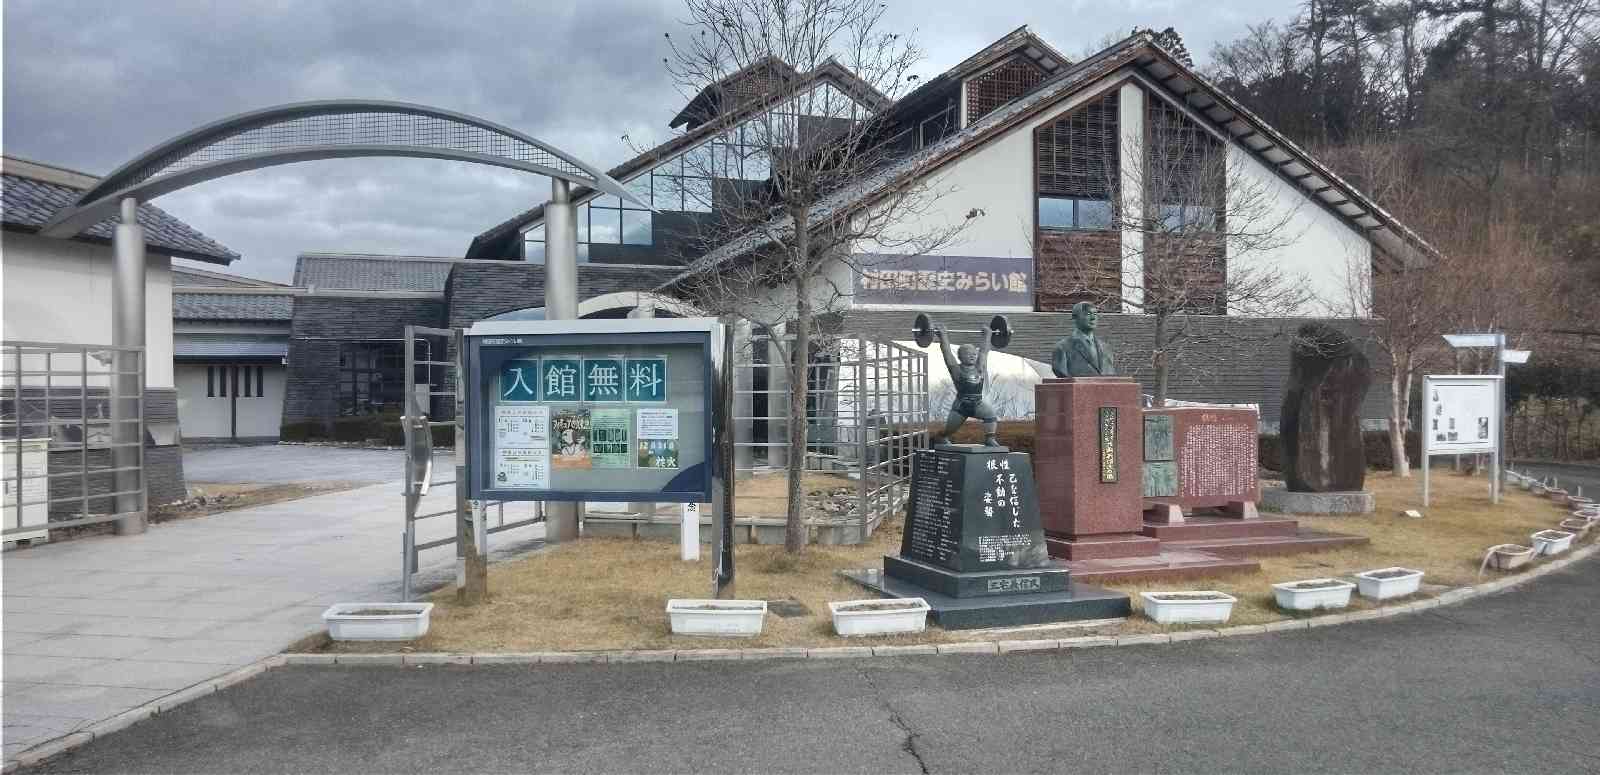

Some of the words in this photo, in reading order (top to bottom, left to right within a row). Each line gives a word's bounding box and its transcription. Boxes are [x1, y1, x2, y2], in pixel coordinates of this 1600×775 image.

[503, 364, 663, 397] 入館無料
[987, 459, 1010, 470] 根性
[995, 473, 1006, 507] 不動の
